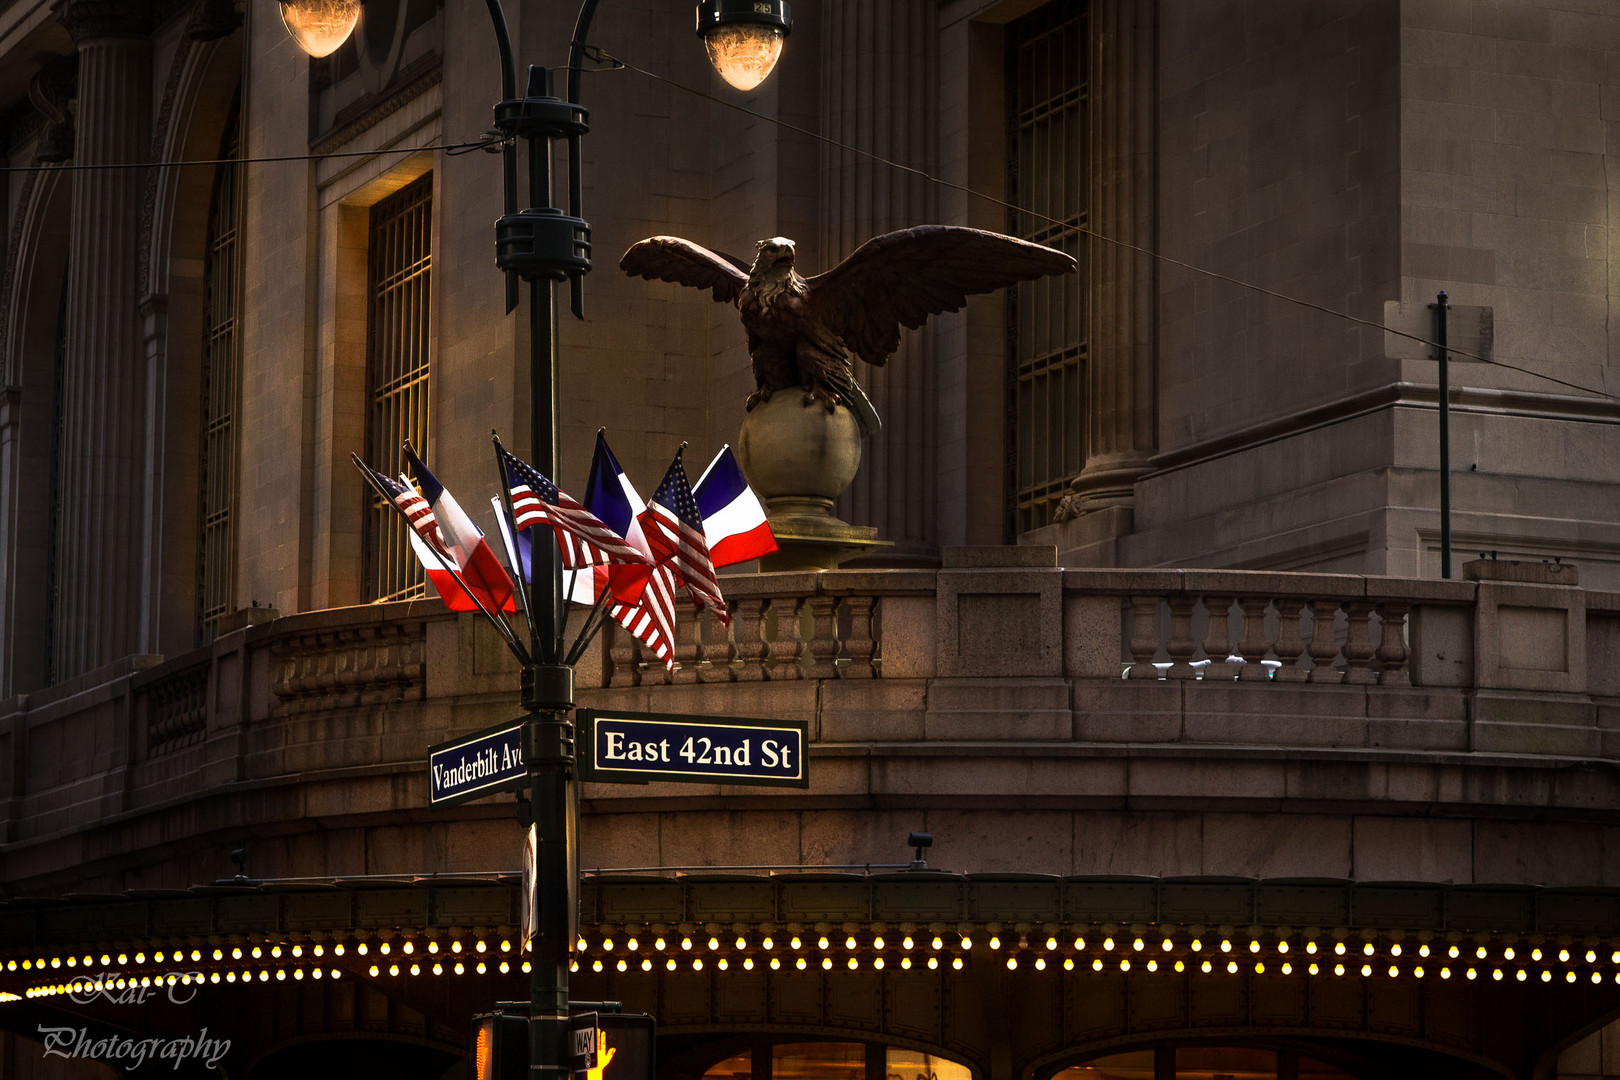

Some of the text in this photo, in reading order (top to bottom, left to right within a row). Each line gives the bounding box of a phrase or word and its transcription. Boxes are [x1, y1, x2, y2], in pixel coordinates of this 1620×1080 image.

[755, 3, 770, 12] 25
[604, 731, 792, 769] East 42nd St
[432, 747, 499, 792] Vanderbilt
[576, 1030, 593, 1053] WAY
